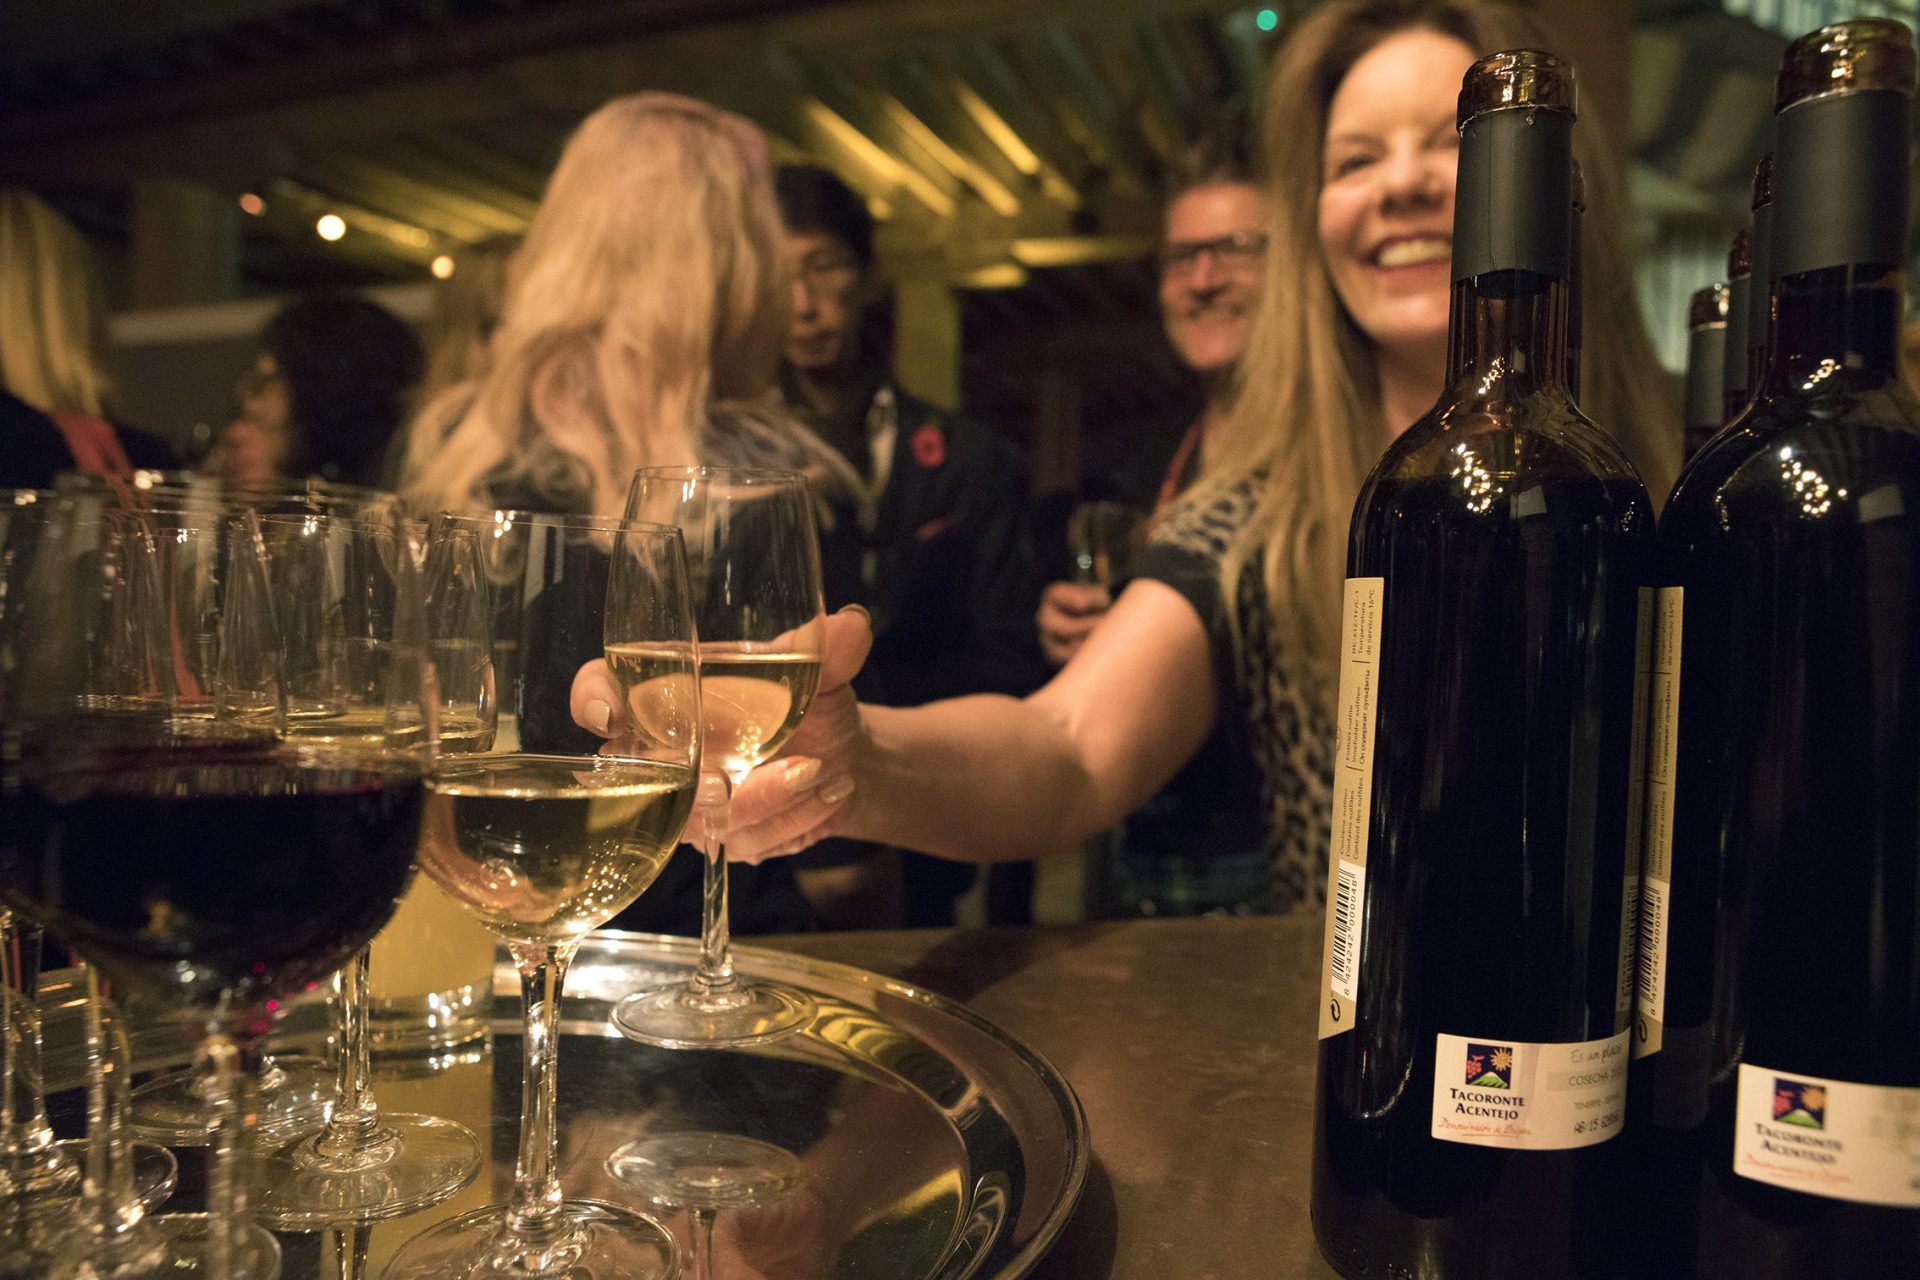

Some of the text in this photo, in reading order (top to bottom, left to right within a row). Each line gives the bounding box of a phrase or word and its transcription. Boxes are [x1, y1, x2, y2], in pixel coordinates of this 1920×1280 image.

[1358, 602, 1366, 654] Temperatura
[1363, 669, 1371, 711] сульфиты
[1360, 712, 1368, 751] содержит
[1345, 821, 1353, 857] Contains
[1353, 825, 1361, 860] Contient
[1344, 879, 1358, 996] 8 424242 000048
[1571, 1050, 1584, 1063] Es
[1450, 1087, 1525, 1107] TACORONTE
[1455, 1102, 1519, 1120] ACENTEJO
